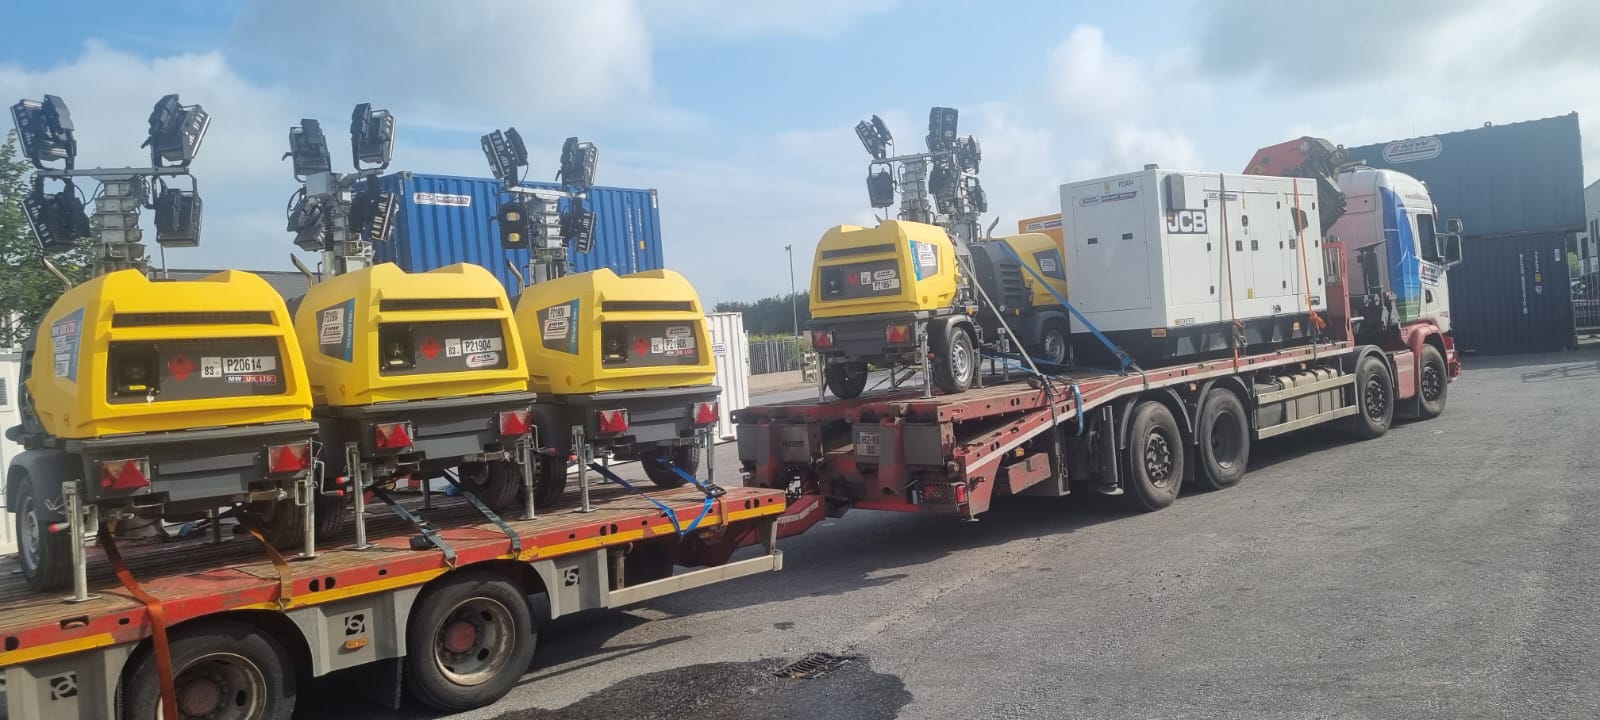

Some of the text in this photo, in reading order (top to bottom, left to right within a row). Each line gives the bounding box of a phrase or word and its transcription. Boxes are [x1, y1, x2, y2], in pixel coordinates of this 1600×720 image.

[1167, 210, 1207, 233] JCB
[465, 339, 491, 352] P21904
[226, 358, 262, 372] P20614
